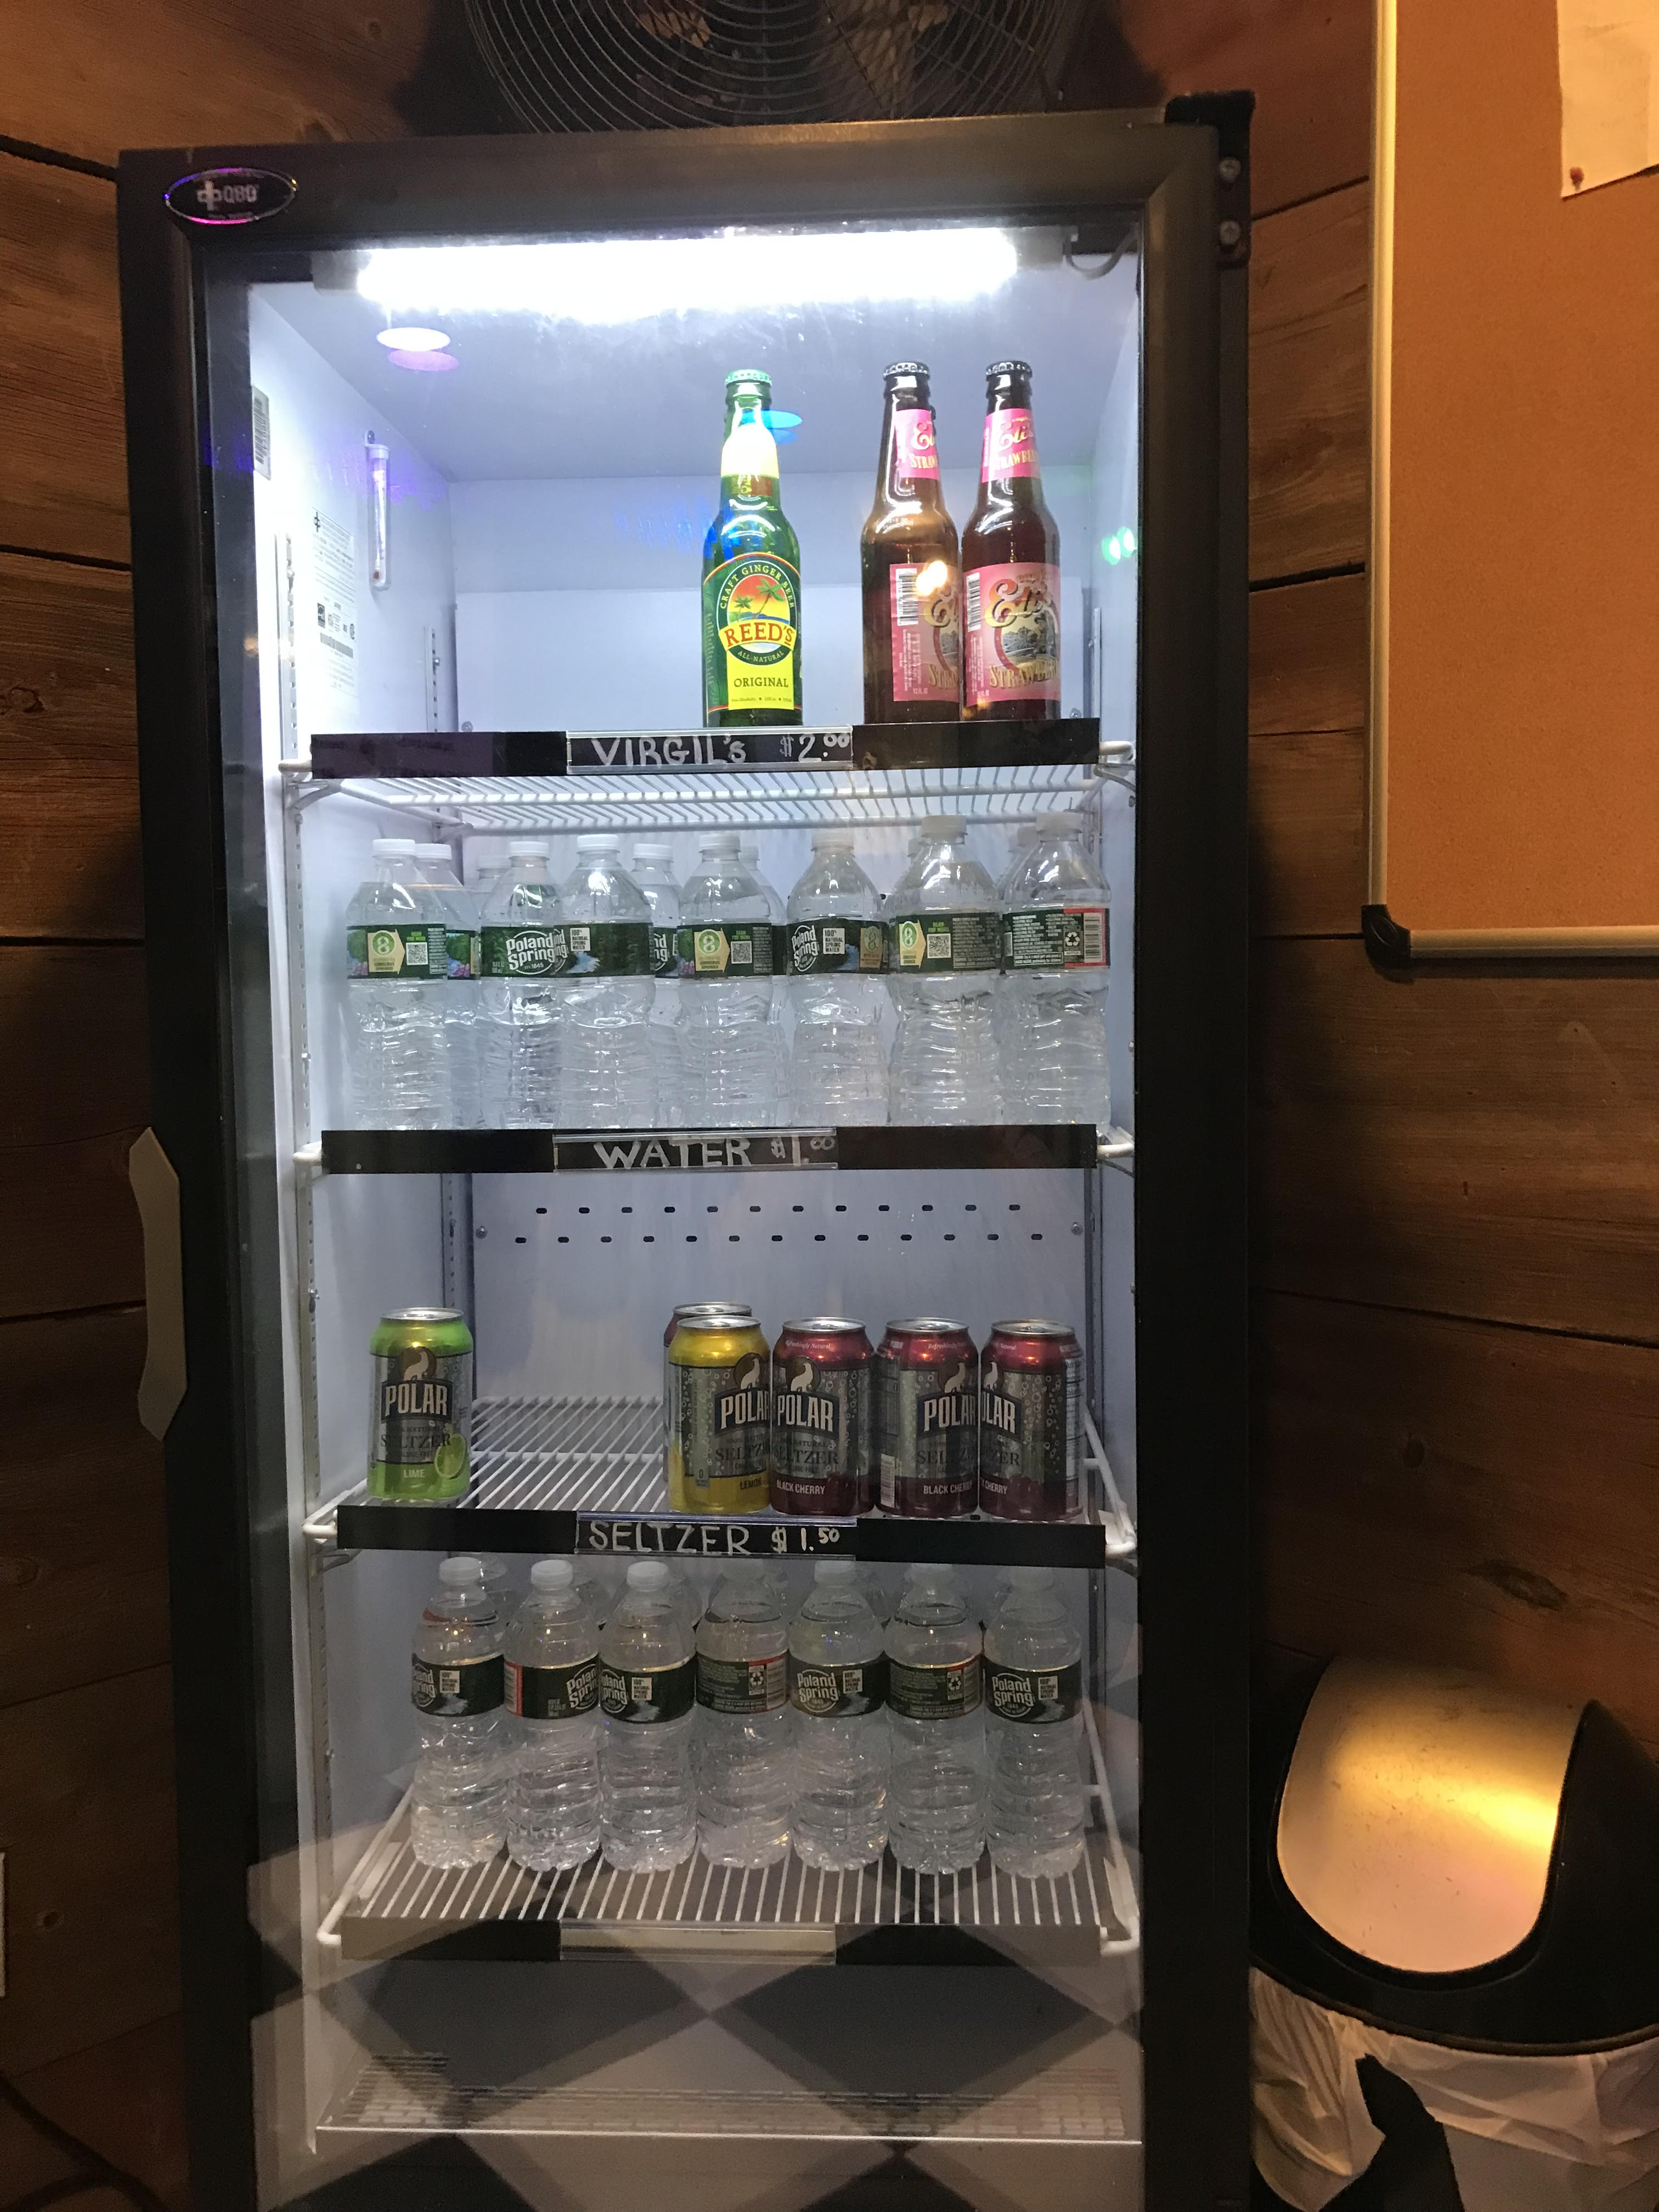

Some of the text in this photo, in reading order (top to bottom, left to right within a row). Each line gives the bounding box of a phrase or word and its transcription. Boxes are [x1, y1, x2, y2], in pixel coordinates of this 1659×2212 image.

[720, 565, 795, 609] CRAFT GINGER BEER
[724, 622, 794, 647] REED'S
[738, 651, 785, 662] ALL NATURAL
[734, 677, 789, 687] ORIGINAL
[506, 932, 555, 956] Poland
[507, 948, 556, 970] Spring
[594, 1136, 752, 1170] WATER
[385, 1383, 448, 1416] POLAR
[777, 1394, 833, 1432] POLAR
[924, 1394, 976, 1432] POLAR
[403, 1469, 425, 1478] LIME
[777, 1479, 825, 1494] BLACK CHERRY
[923, 1485, 948, 1494] BLACK
[589, 1520, 751, 1556] SELTZER
[797, 1672, 836, 1688] Poland
[992, 1677, 1031, 1692] Poland
[799, 1686, 839, 1702] Spring
[994, 1690, 1034, 1707] Spring
